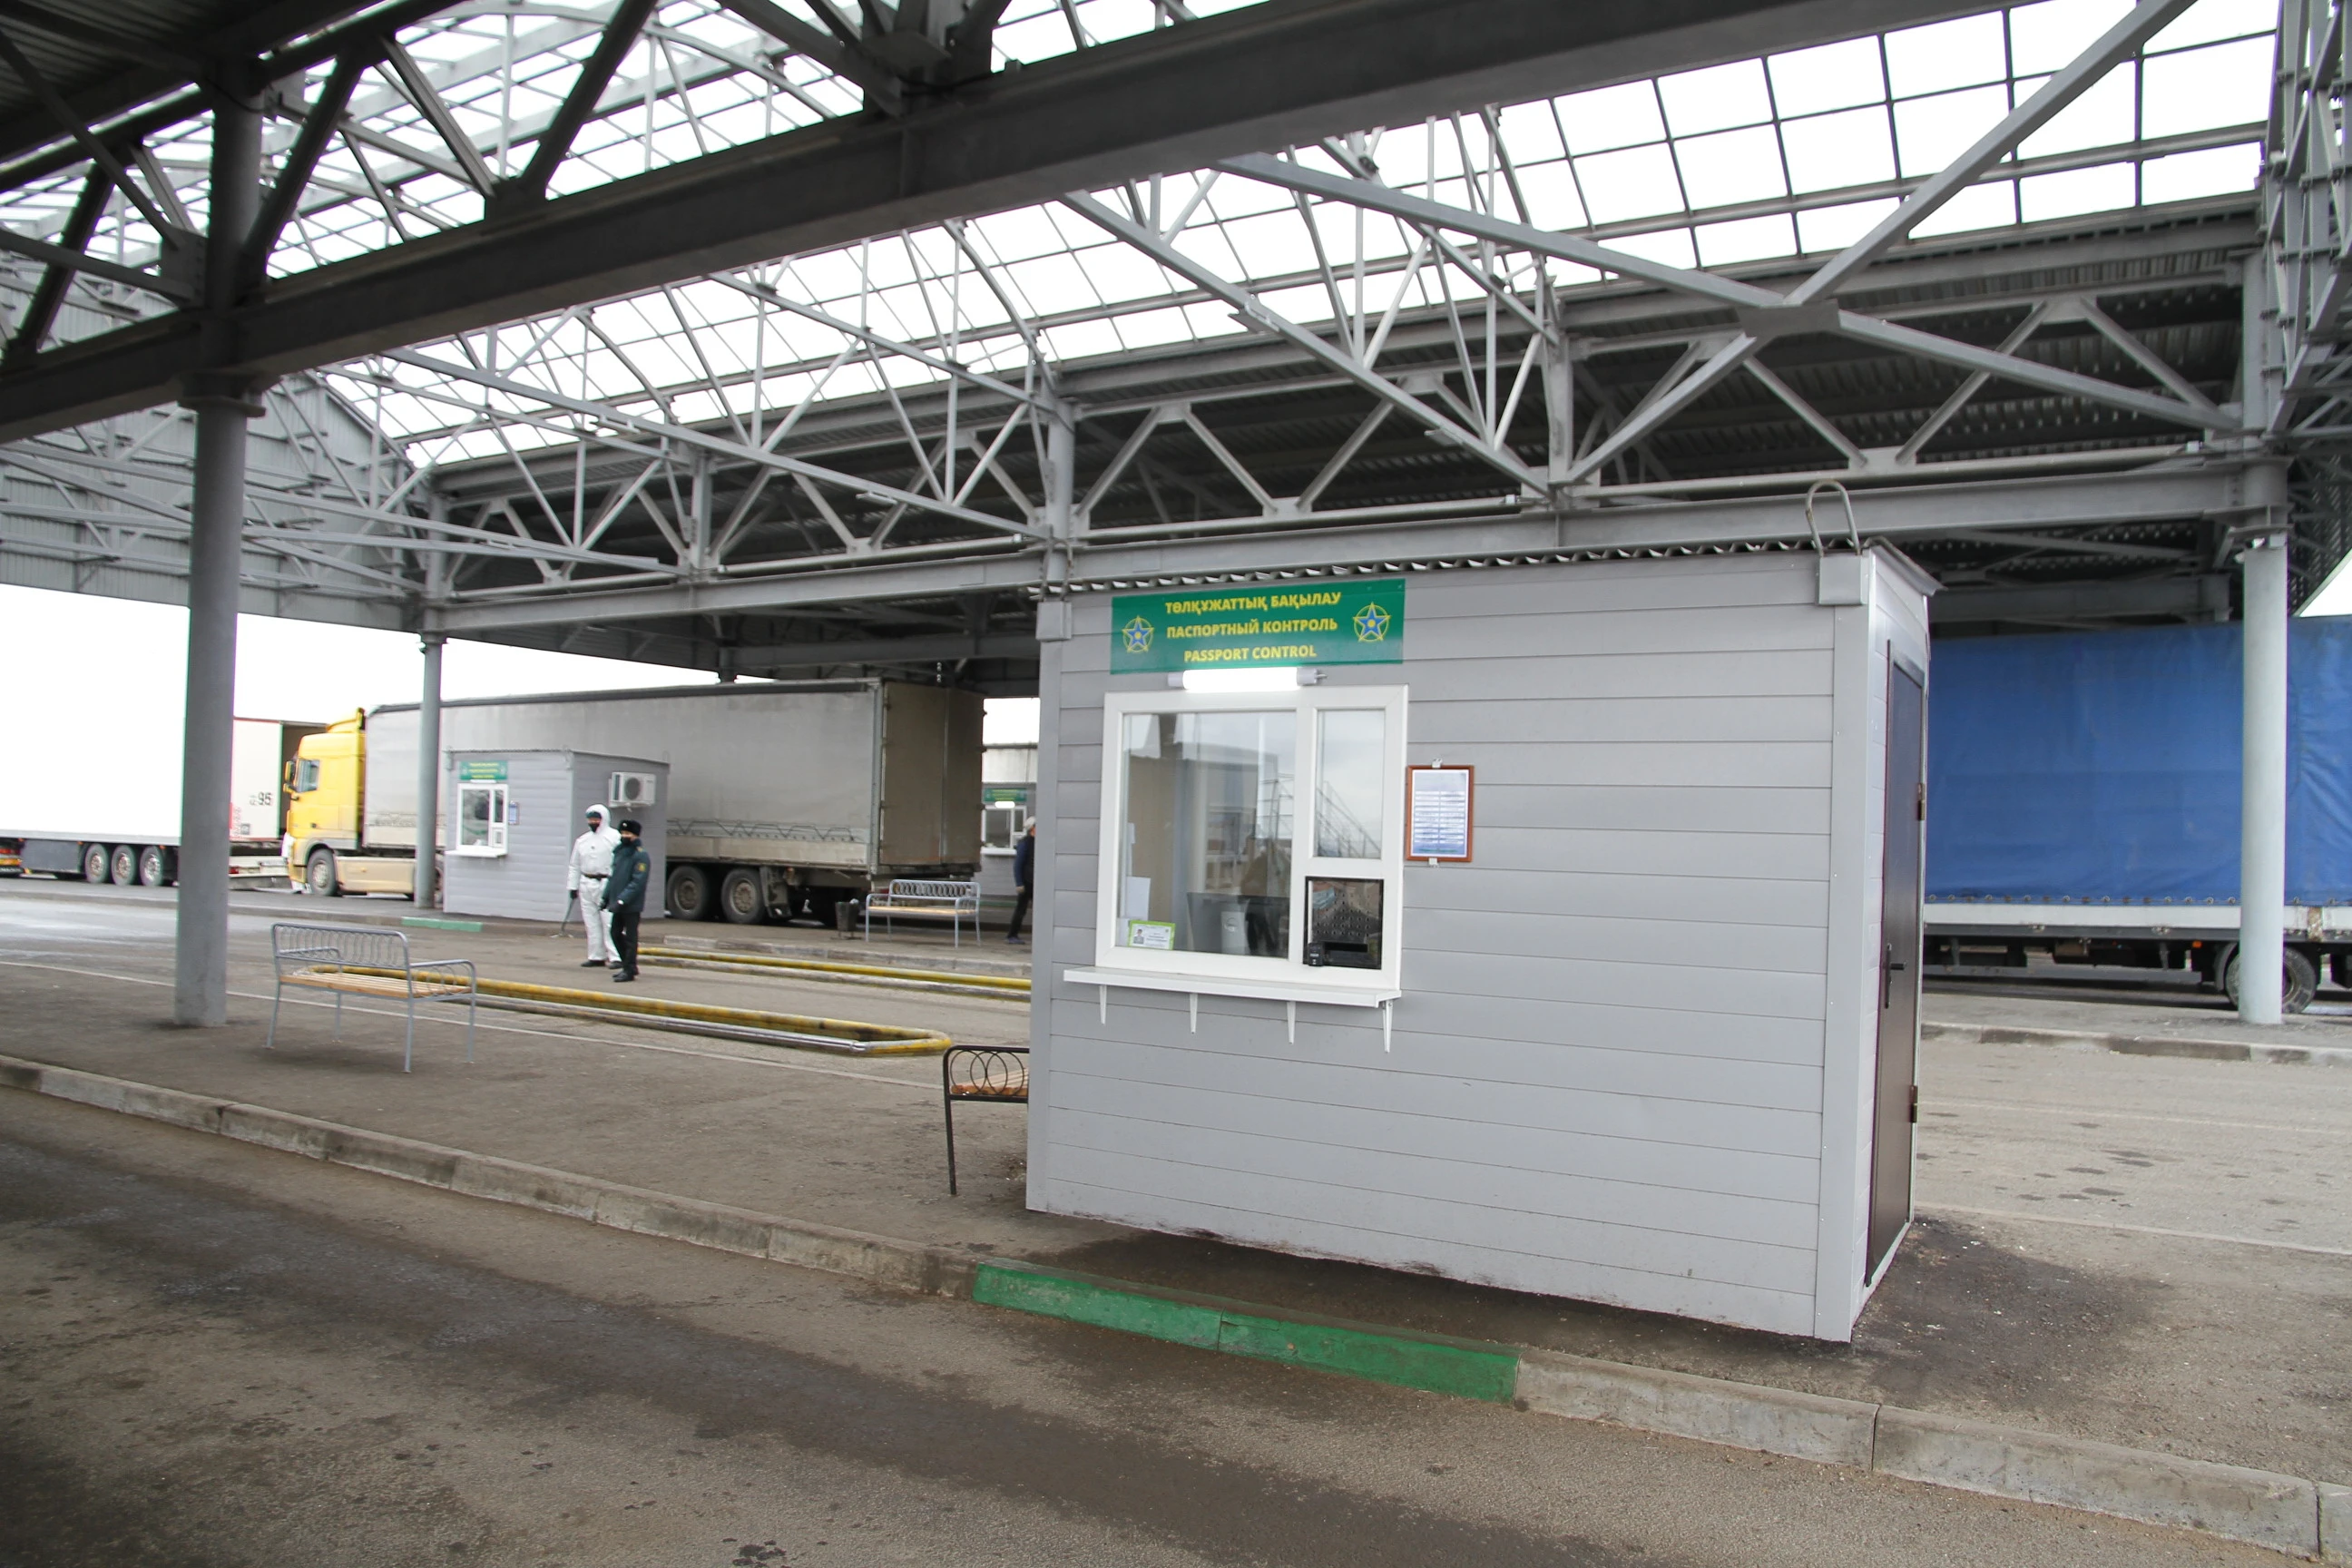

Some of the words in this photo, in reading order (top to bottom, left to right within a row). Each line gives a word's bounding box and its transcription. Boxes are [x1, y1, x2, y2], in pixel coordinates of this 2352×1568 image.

[1165, 596, 1268, 614] ТӨЛҚҰЖАТТЫҚ
[1271, 592, 1341, 609] БАҚЫЛАУ
[1167, 619, 1259, 638] ПАСПОРТНЫЙ
[1263, 618, 1338, 633] КОНТРОЛЬ
[1184, 647, 1249, 662] PASSPORT
[1252, 644, 1317, 660] CONTROL
